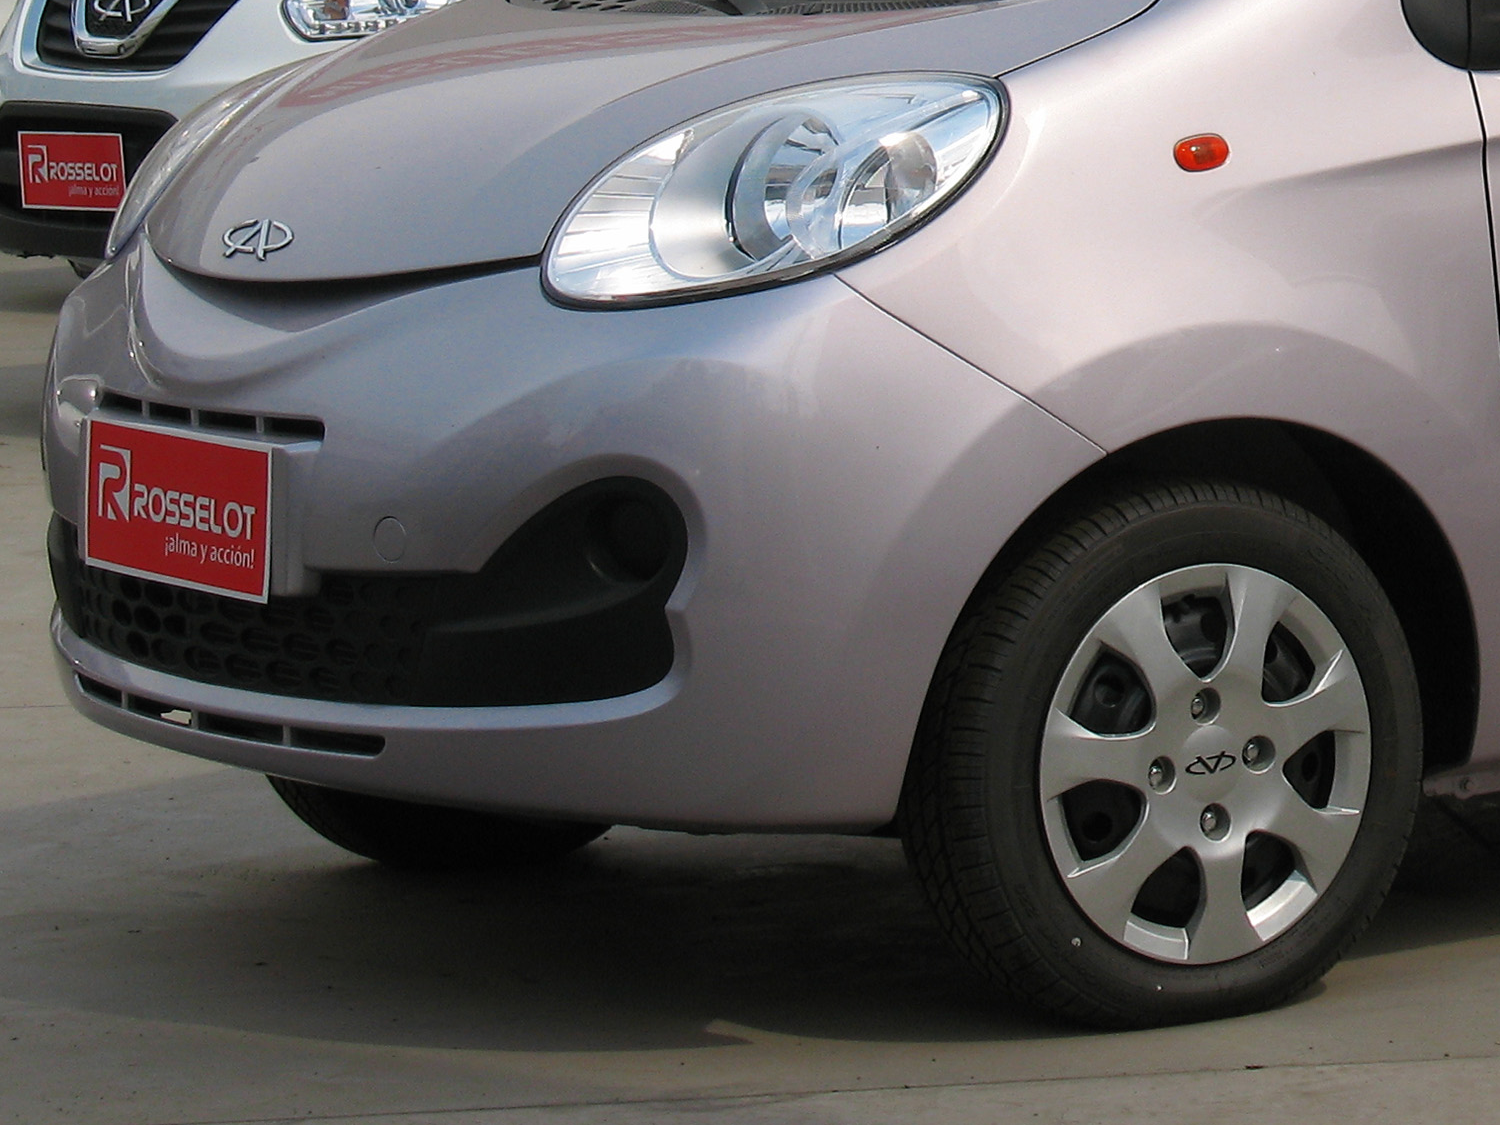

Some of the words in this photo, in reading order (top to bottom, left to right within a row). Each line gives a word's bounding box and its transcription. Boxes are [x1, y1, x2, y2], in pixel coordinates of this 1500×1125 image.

[49, 161, 118, 183] ROSSELOT
[133, 482, 257, 541] ROSSELOT
[164, 532, 198, 558] ¡alma
[200, 545, 208, 565] y
[210, 545, 256, 570] acción!
